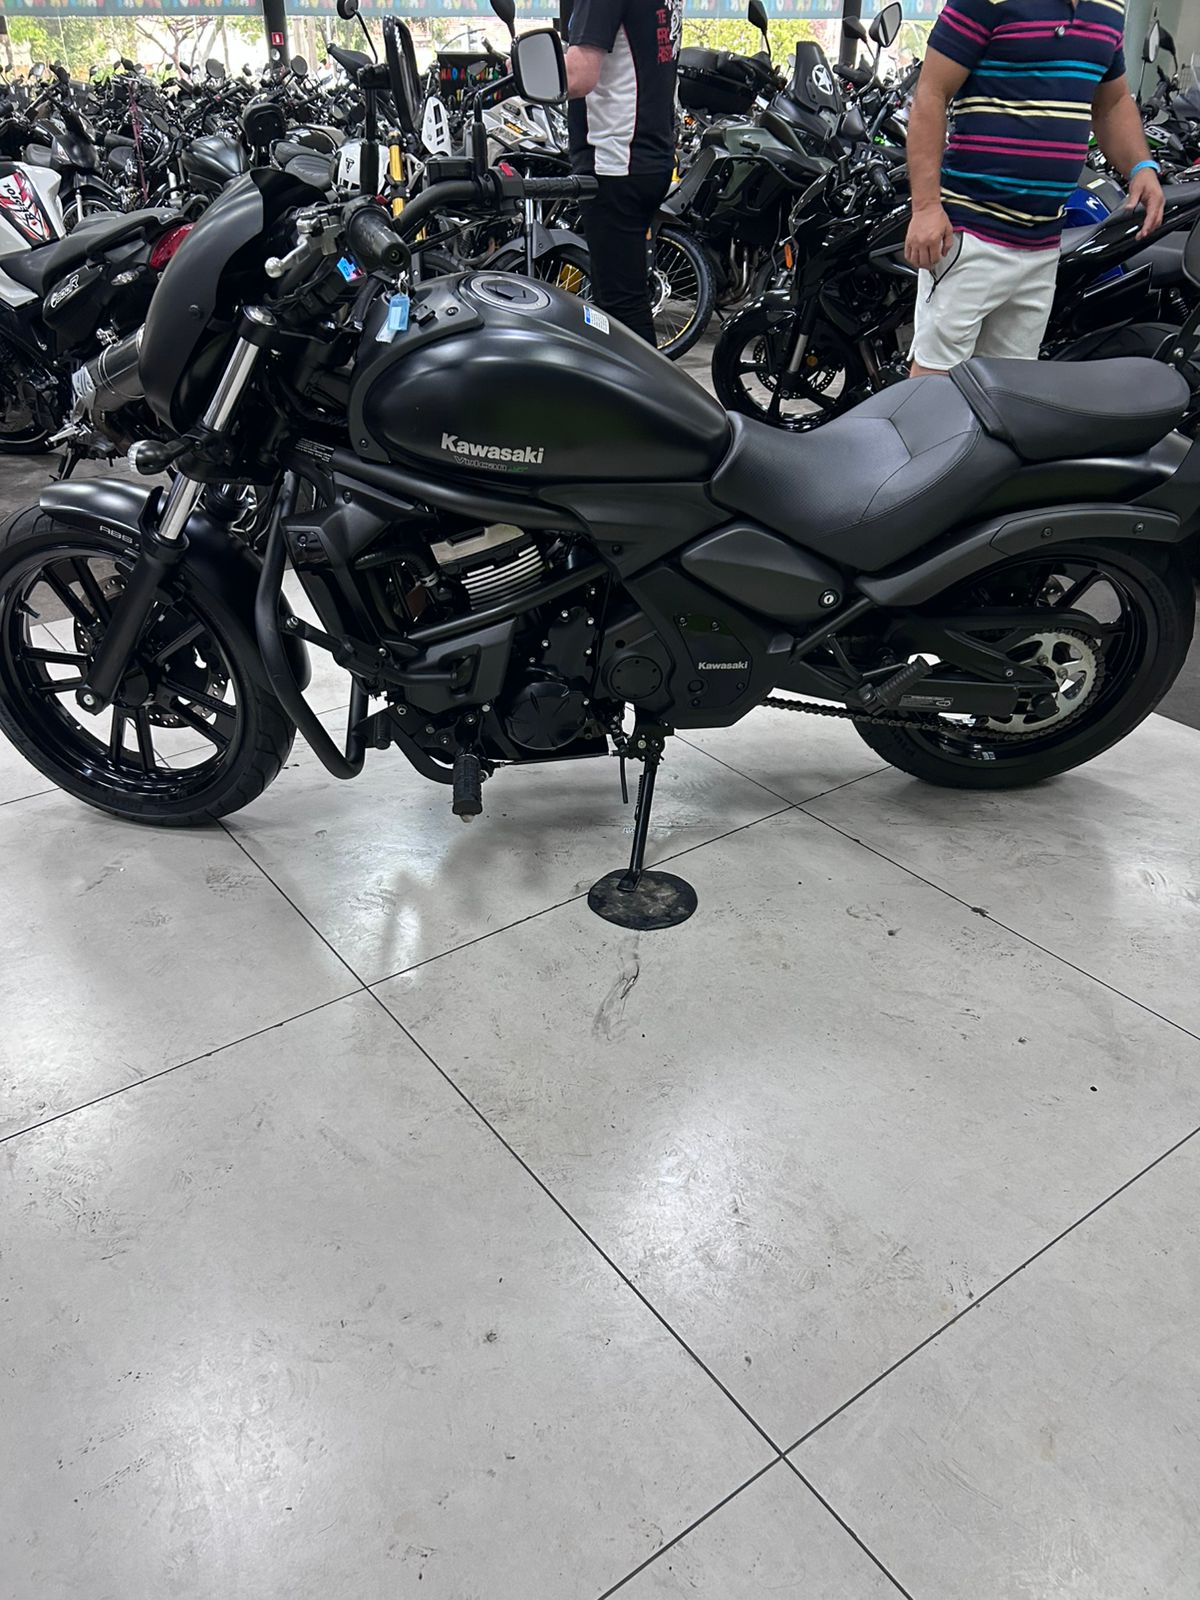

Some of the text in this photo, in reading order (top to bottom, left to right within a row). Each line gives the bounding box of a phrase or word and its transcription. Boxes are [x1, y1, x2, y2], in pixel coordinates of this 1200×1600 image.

[441, 432, 545, 464] Kawasaki
[99, 525, 133, 544] ABS
[698, 661, 748, 670] Kawasaki
